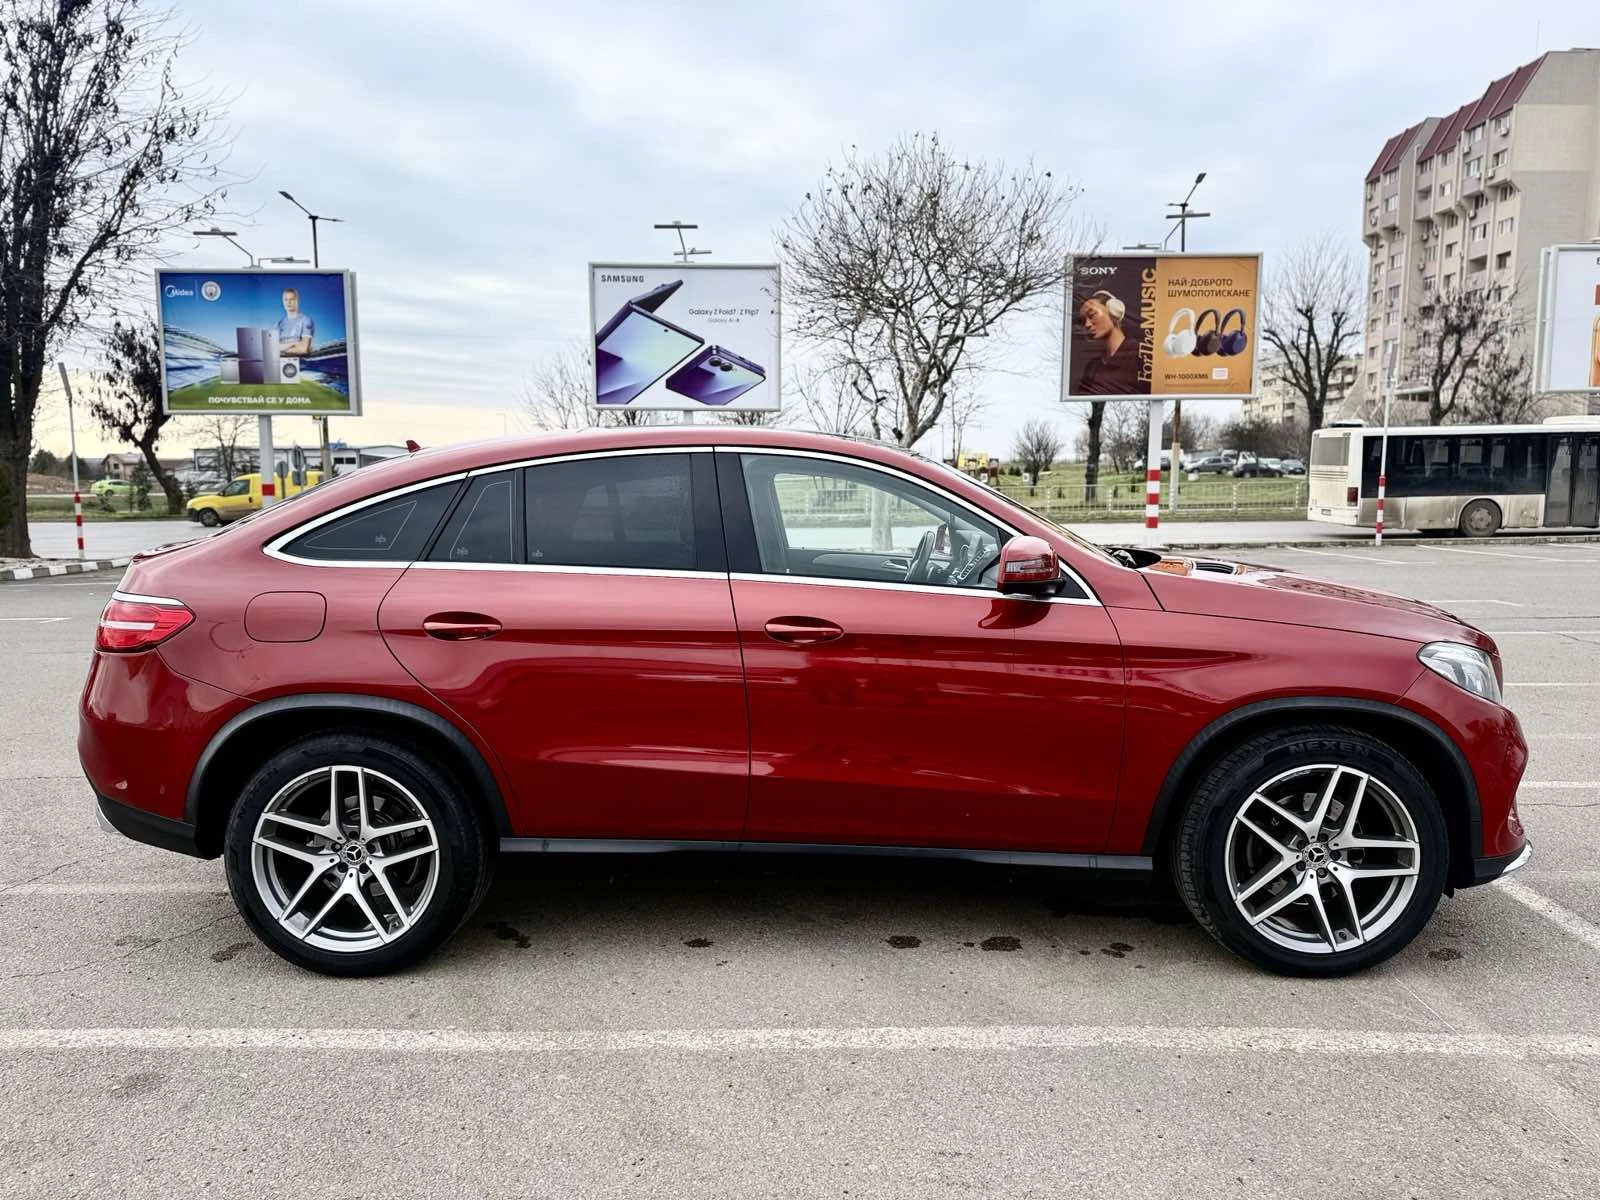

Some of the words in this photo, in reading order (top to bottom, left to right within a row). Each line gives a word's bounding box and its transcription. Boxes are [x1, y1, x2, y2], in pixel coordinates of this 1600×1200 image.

[1080, 266, 1118, 275] SONY
[601, 274, 645, 283] SAMSUNG
[1168, 277, 1233, 287] НАЙ-ДОБРОТО
[167, 286, 194, 297] Midea
[1168, 289, 1251, 297] ШУМОПОТИСКАНЕ
[688, 308, 713, 316] Galaxy
[744, 308, 760, 316] Flip7
[208, 394, 265, 404] ПОЧУВСТВАЙ
[265, 396, 277, 404] СЕ
[277, 396, 284, 404] У
[286, 396, 312, 405] ДОМА
[1289, 741, 1369, 756] NEXEN
